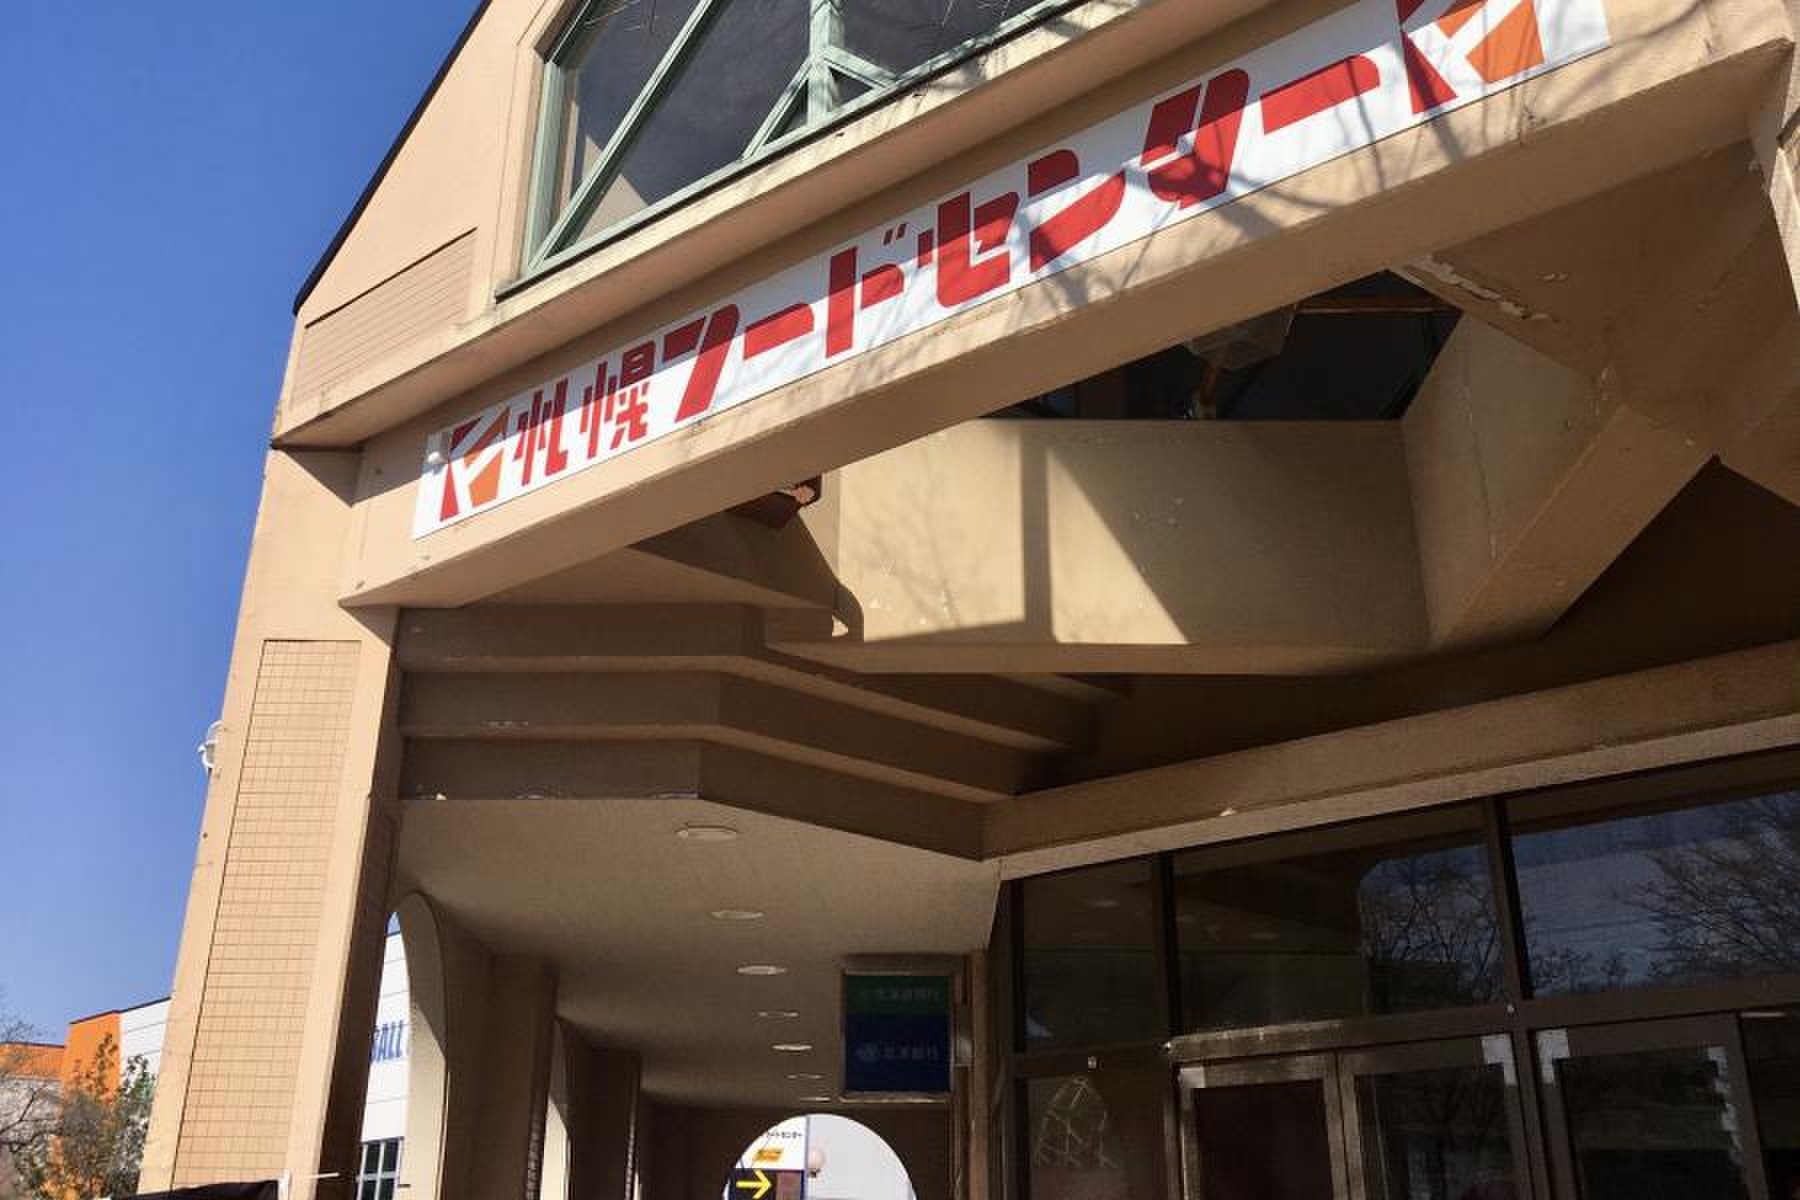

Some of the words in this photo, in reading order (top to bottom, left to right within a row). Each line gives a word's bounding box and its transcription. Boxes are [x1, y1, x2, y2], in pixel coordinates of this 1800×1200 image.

[513, 54, 1382, 487] 札幌フードセンター
